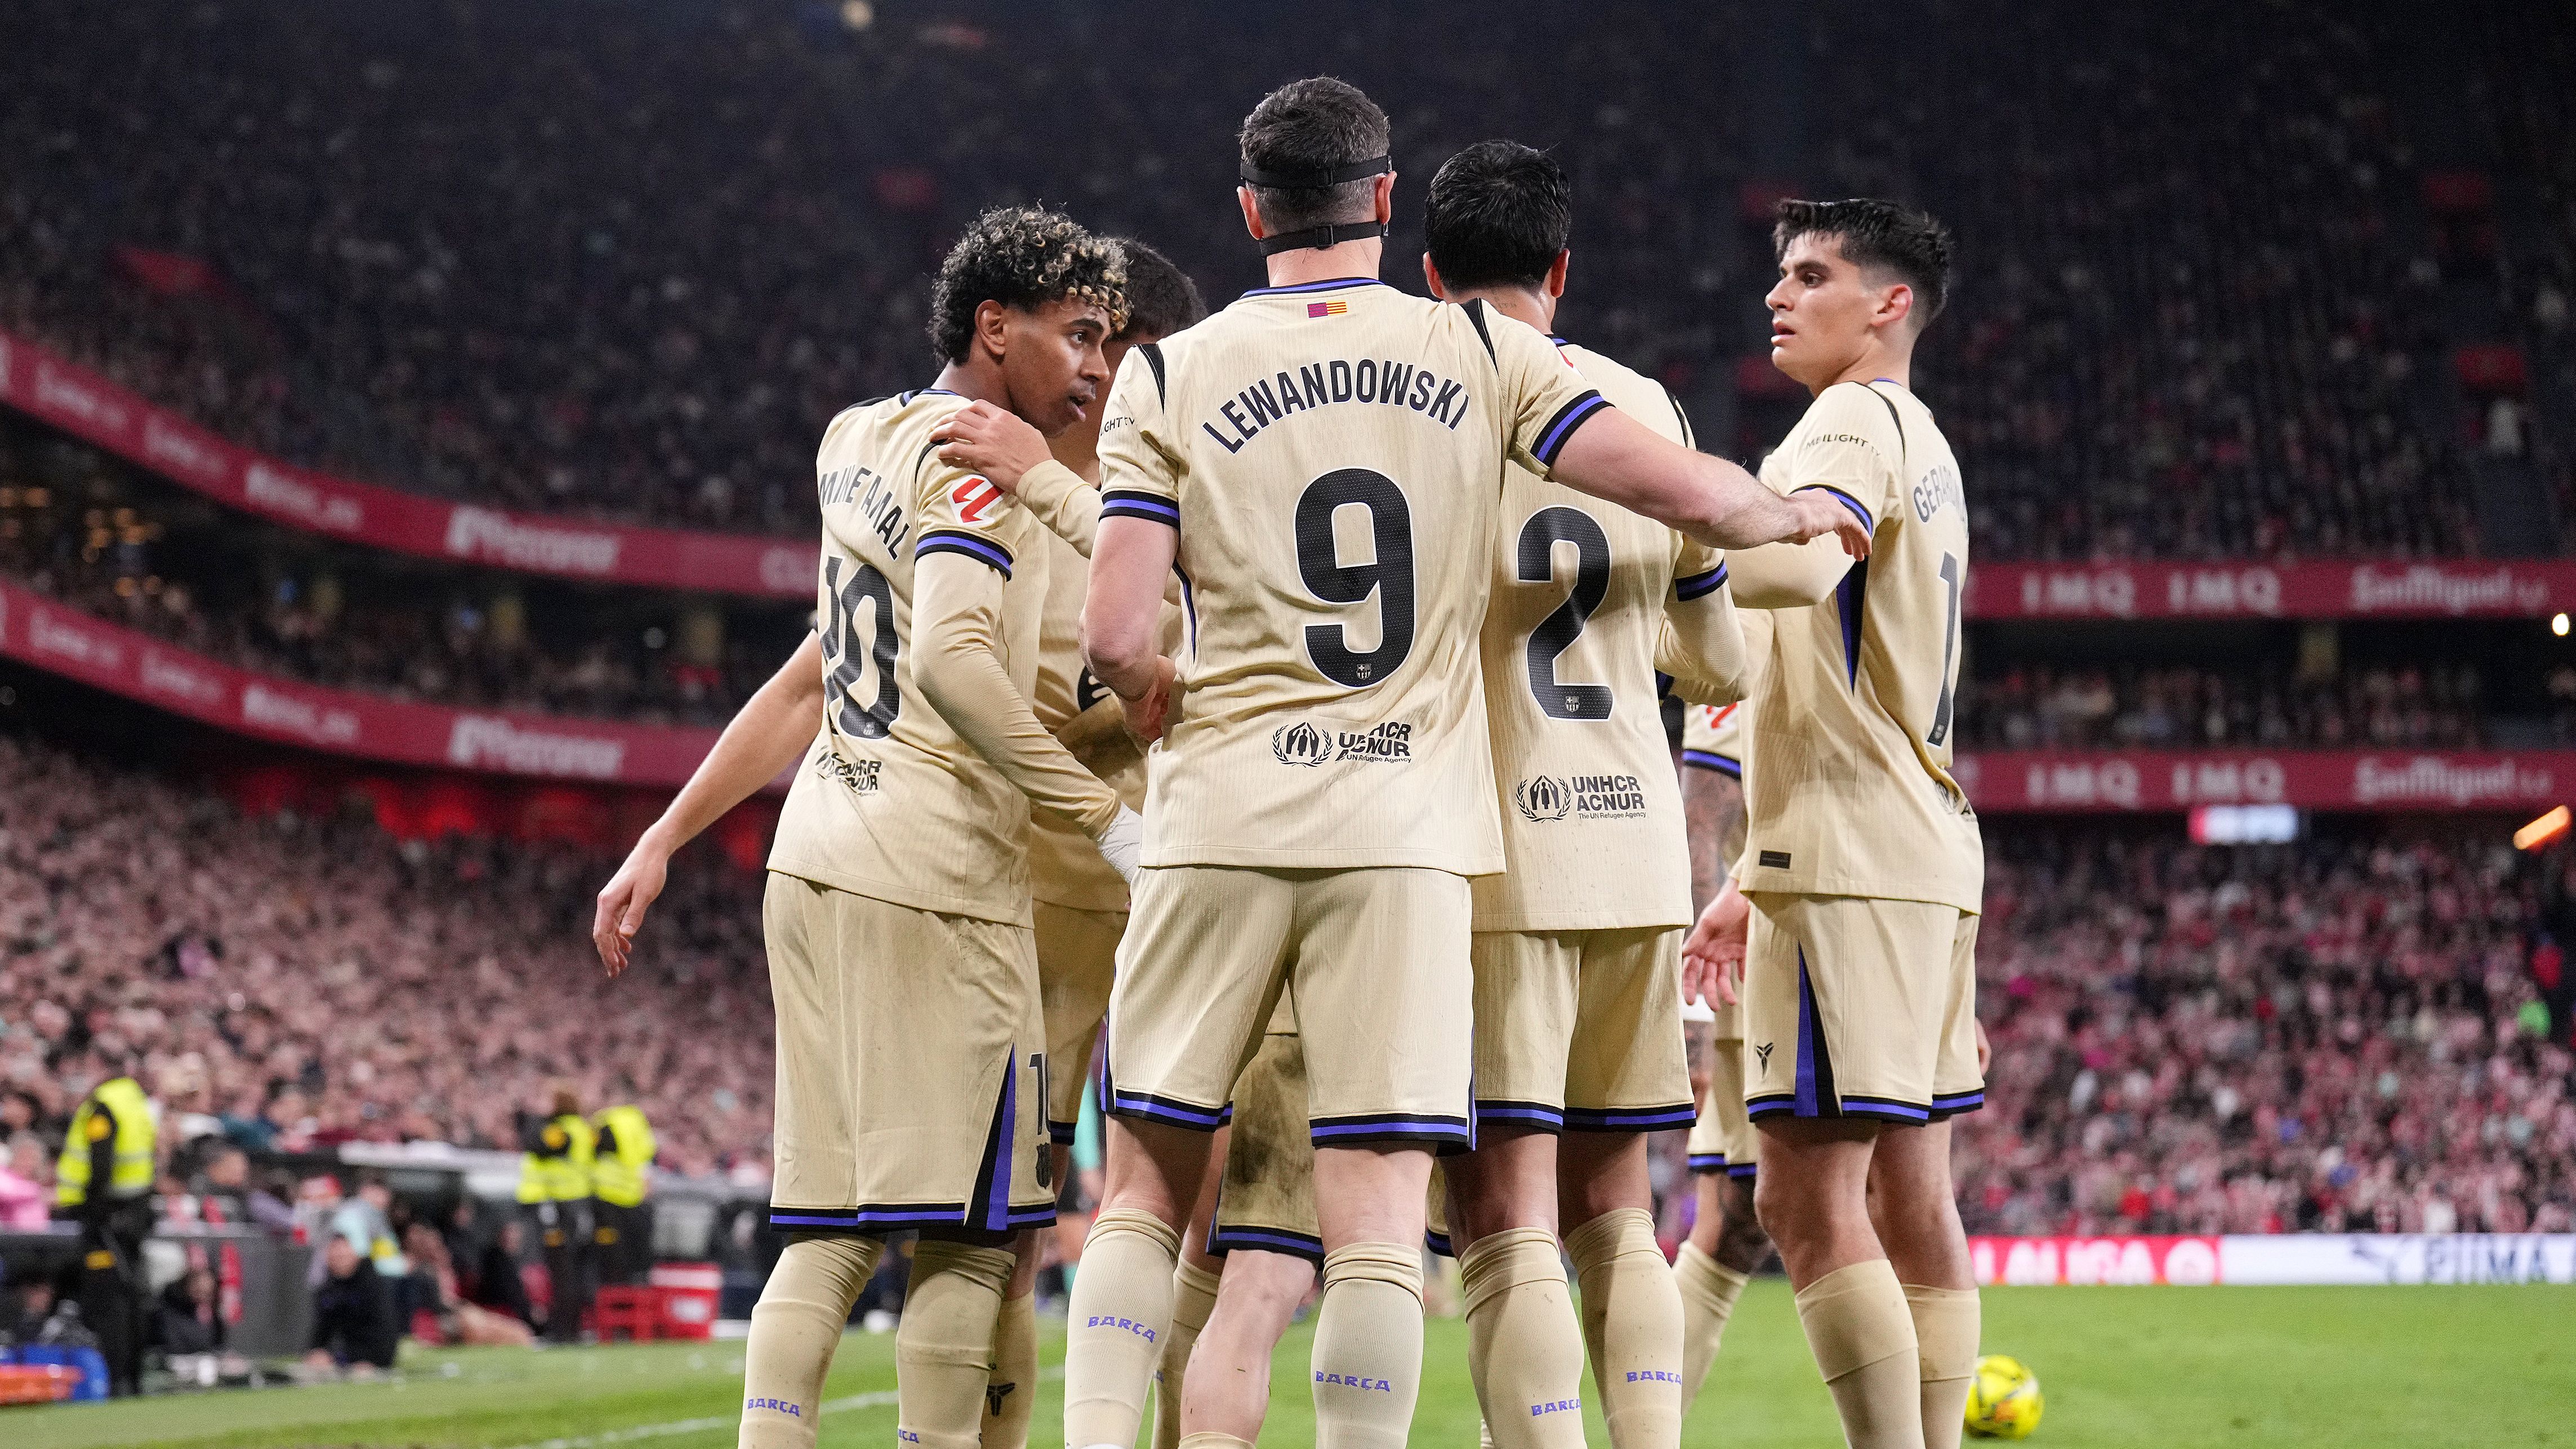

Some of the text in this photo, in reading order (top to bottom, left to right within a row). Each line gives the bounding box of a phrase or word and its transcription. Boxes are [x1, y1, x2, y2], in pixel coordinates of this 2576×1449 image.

[1100, 417, 1122, 436] LIGHT
[1203, 359, 1469, 454] LEWANDOWSKI
[819, 463, 911, 561] MINE AMAL
[1293, 466, 1416, 690] 9
[1516, 505, 1615, 721] 2
[820, 556, 901, 739] 10
[1926, 548, 1959, 748] 1
[1572, 775, 1641, 793] UNHCR
[1577, 793, 1645, 811] ACNUR
